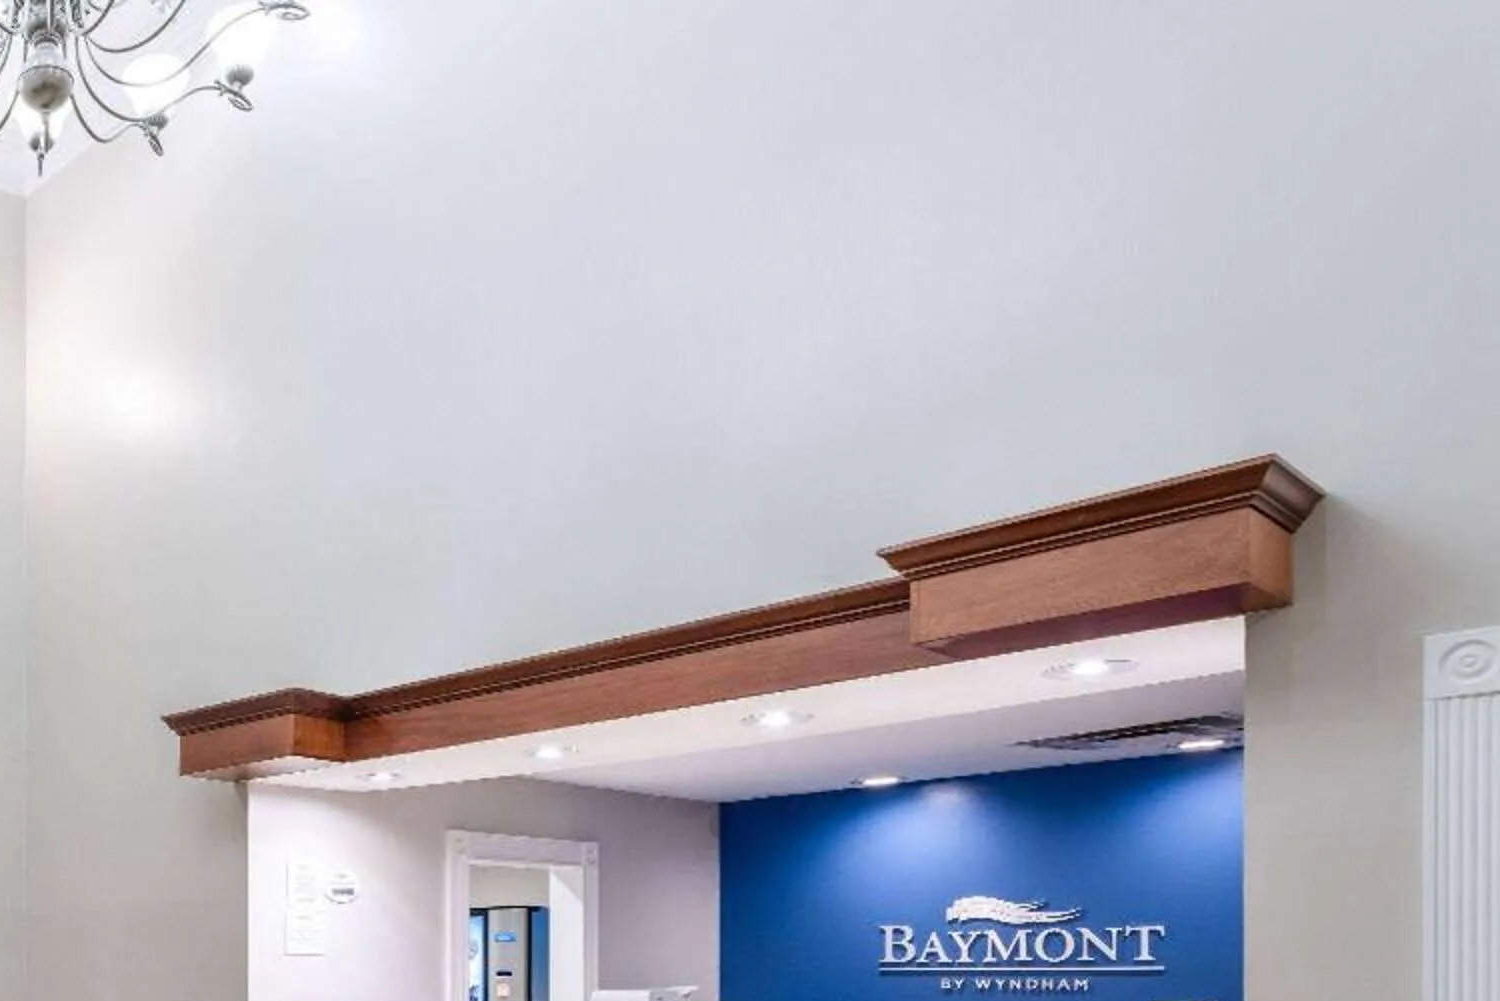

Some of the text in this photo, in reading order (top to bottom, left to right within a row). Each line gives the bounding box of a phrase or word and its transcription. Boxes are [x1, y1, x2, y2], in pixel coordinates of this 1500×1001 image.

[879, 925, 1165, 963] BAYMONT
[940, 976, 1090, 992] BY WYNDHAM
